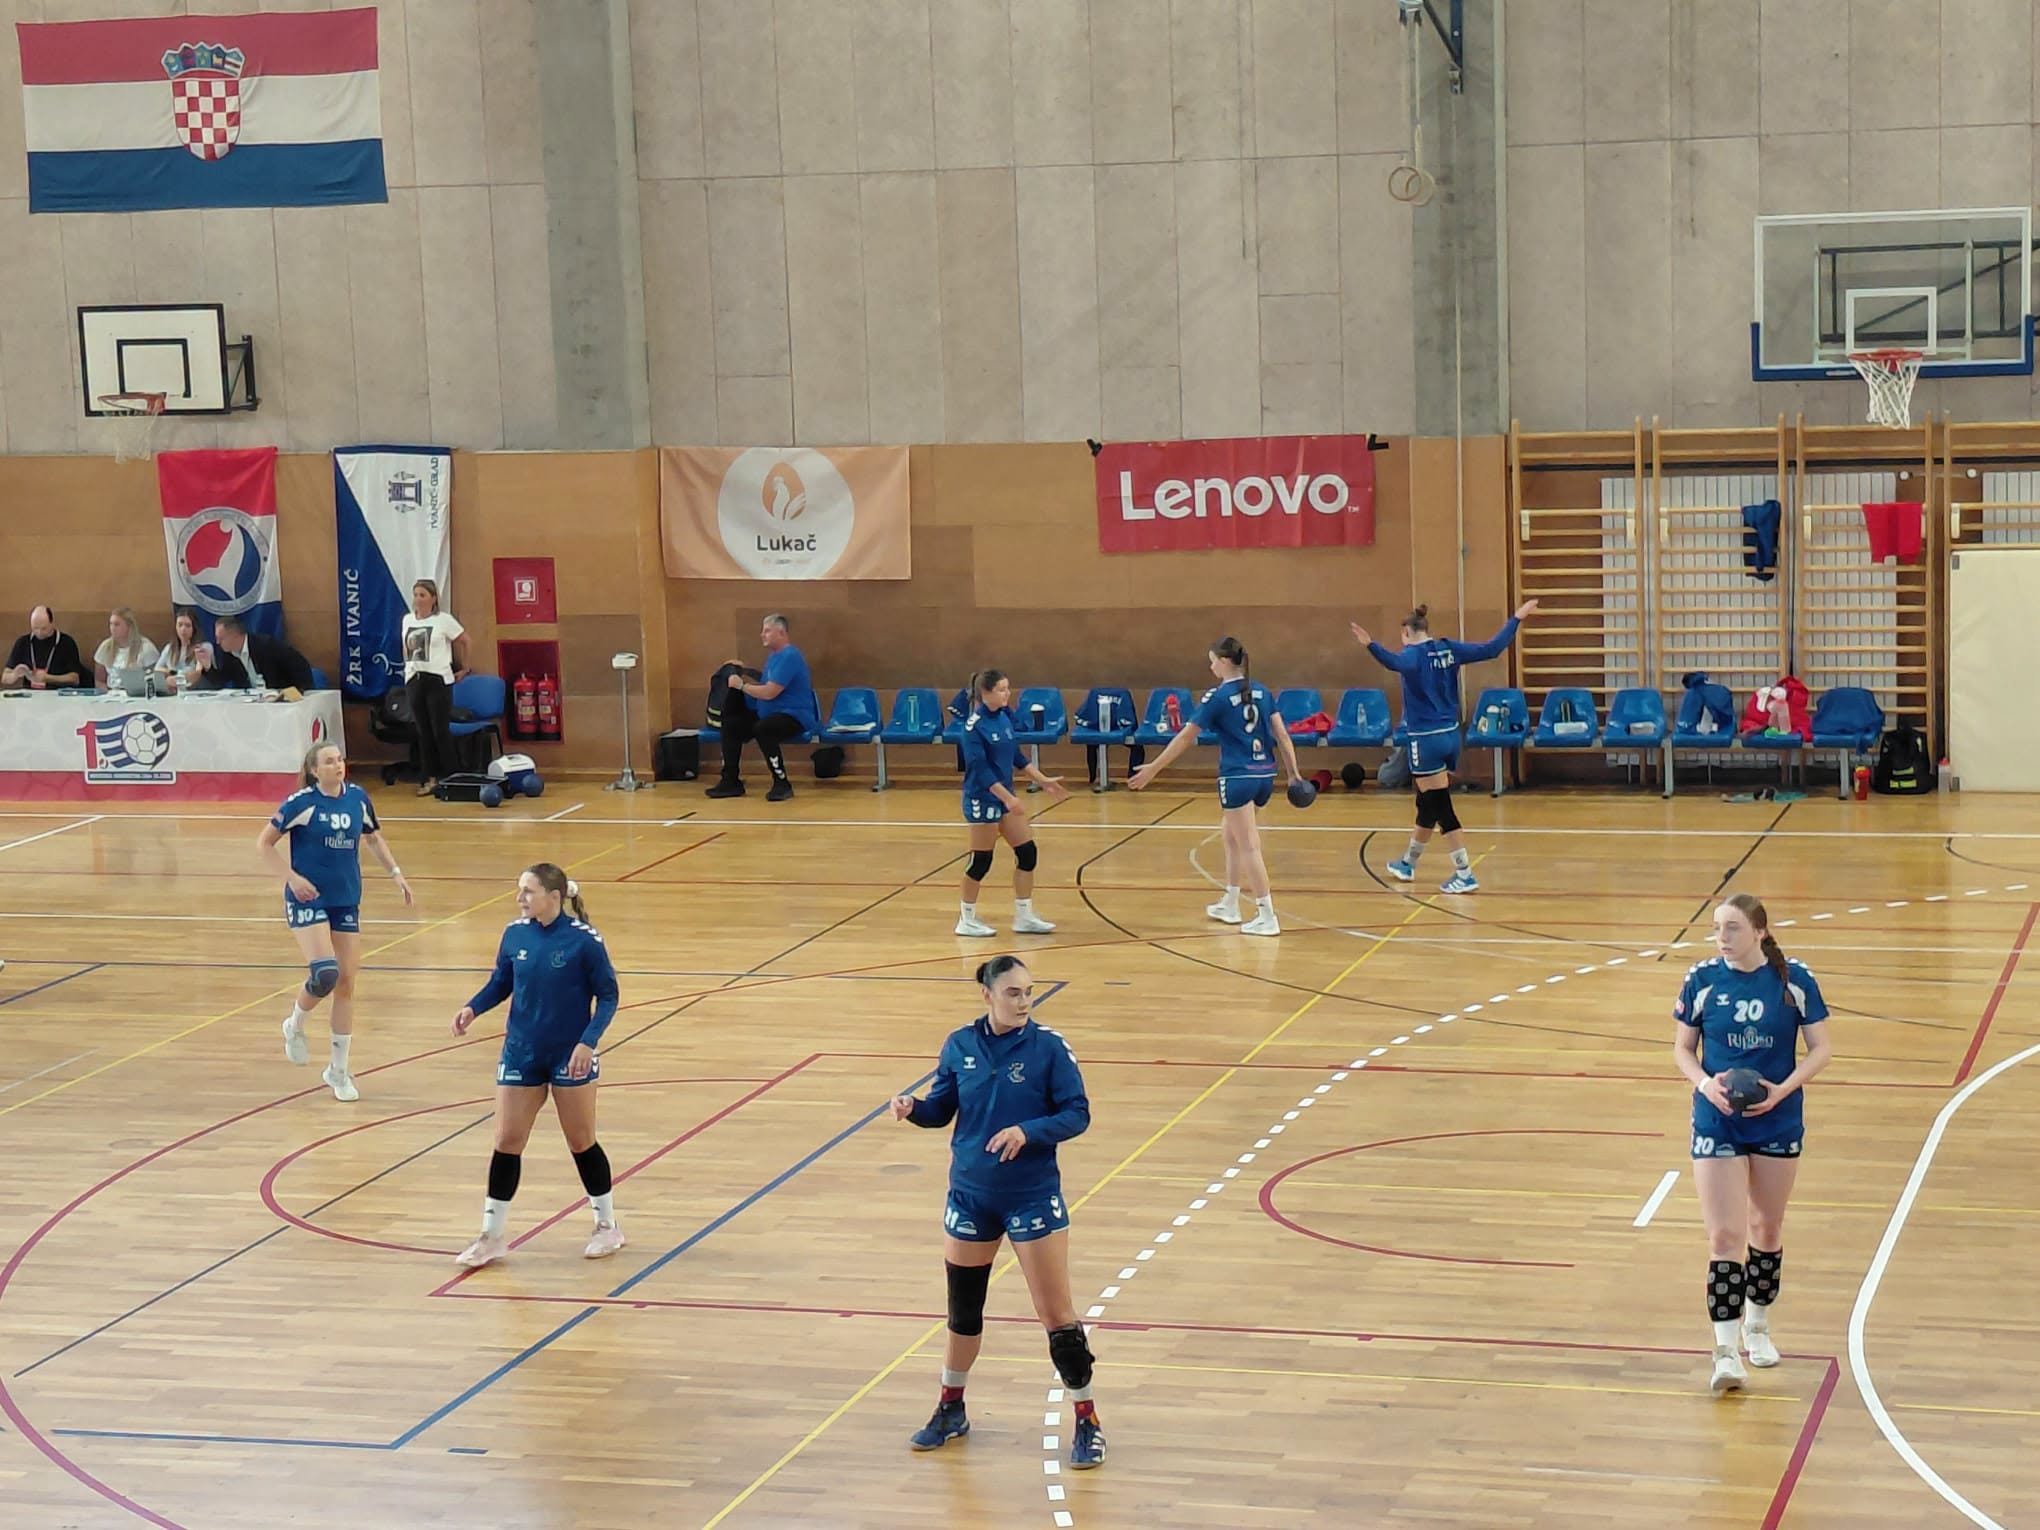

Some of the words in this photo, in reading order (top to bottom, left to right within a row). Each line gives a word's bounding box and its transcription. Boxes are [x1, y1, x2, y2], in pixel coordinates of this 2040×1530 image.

[1119, 471, 1349, 520] Lenovo
[757, 533, 817, 551] Lukač
[343, 568, 361, 637] IVANIĆ
[346, 645, 363, 686] ŽRK
[1733, 998, 1764, 1022] 20
